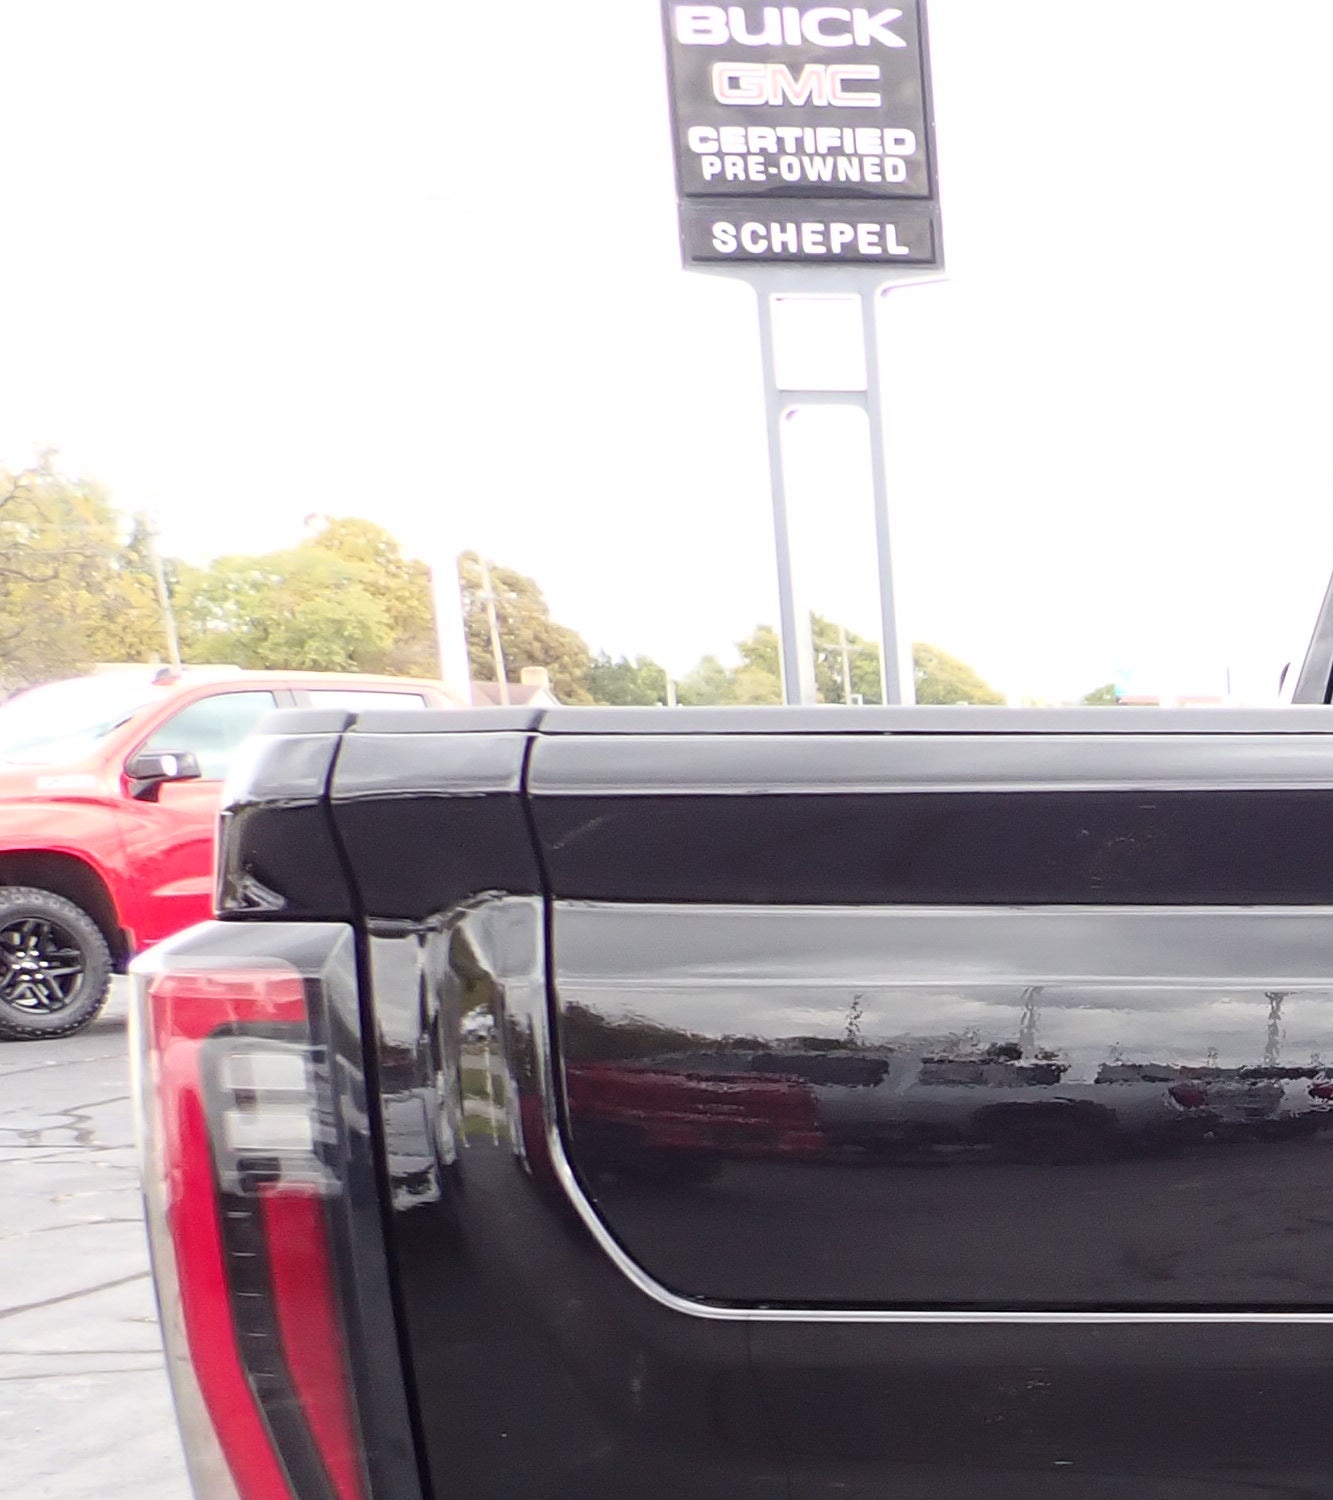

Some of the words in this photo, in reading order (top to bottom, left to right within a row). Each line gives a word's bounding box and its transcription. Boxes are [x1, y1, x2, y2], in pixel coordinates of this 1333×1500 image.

[675, 6, 907, 48] BUICK
[711, 61, 881, 108] GMC
[687, 126, 916, 155] CERTIFIED
[701, 155, 906, 183] PRE-OWNED
[711, 221, 910, 255] SCHEPEL
